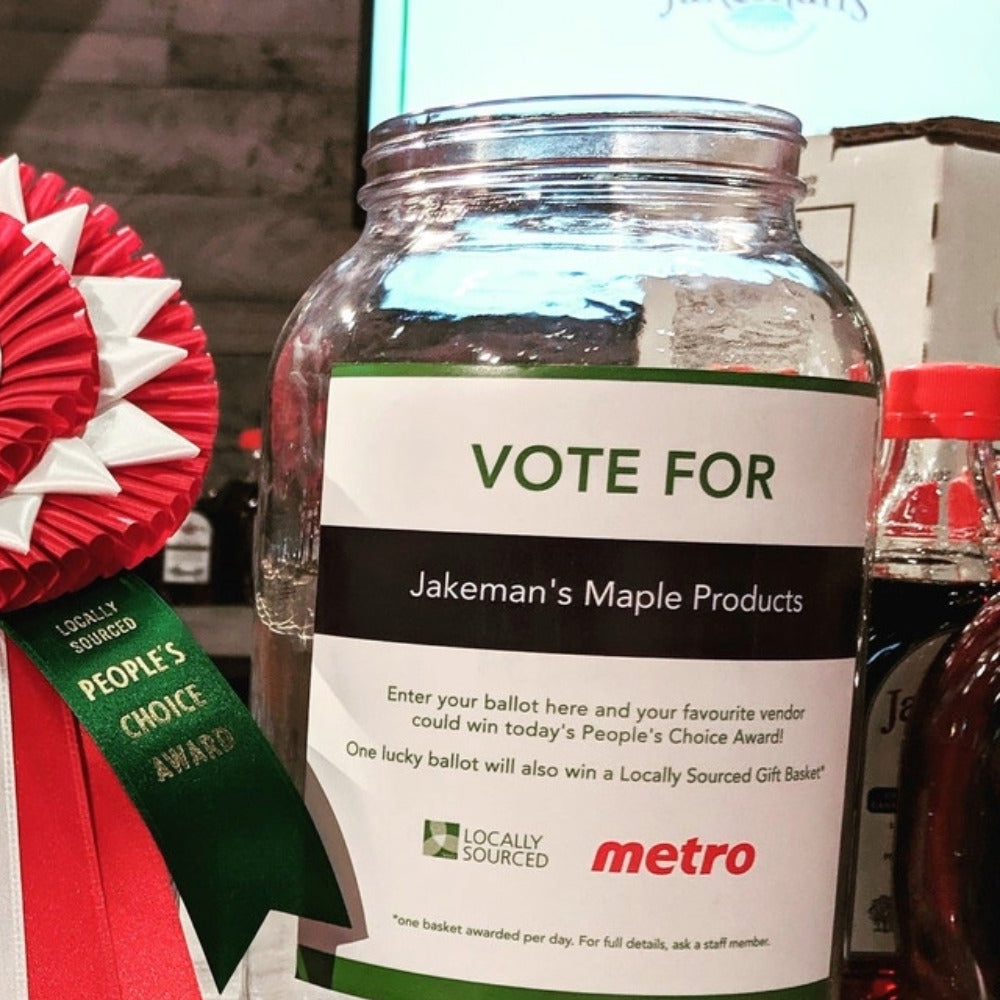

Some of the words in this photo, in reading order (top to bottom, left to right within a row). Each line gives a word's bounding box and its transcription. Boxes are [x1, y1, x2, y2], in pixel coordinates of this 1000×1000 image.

[471, 444, 641, 494] VOTE
[664, 451, 776, 500] FOR
[409, 571, 573, 607] Jakeman's
[584, 578, 682, 616] Maple
[692, 583, 804, 614] Products
[55, 600, 119, 637] LOCALLY
[69, 616, 138, 654] SOURCED
[77, 641, 187, 702] PEOPLE'S
[119, 682, 208, 740] CHOICE
[387, 686, 433, 704] Enter
[436, 694, 478, 710] your
[483, 694, 540, 713] ballot
[545, 698, 589, 716] here
[595, 703, 631, 718] and
[635, 705, 678, 721] your
[683, 703, 756, 721] favourite
[759, 705, 806, 721] vendor
[411, 713, 461, 731] could
[466, 718, 499, 734] win
[505, 721, 576, 743] today's
[581, 725, 663, 746] People's
[668, 728, 729, 745] Choice
[732, 729, 785, 745] Award!
[151, 726, 235, 783] AWARD
[346, 740, 378, 760] One
[381, 745, 424, 769] lucky
[427, 751, 480, 772] ballot
[484, 758, 516, 774] will
[521, 760, 559, 778] also
[564, 764, 597, 780] win
[603, 770, 614, 780] a
[619, 766, 682, 788] Locally
[686, 767, 752, 784] Sourced
[755, 767, 783, 783] Gift
[461, 847, 550, 869] SOURCED
[463, 828, 544, 850] LOCALLY
[590, 836, 757, 876] metro
[422, 919, 463, 935] basket
[465, 925, 520, 942] awarded
[522, 933, 546, 947] per
[548, 933, 575, 947] day.
[578, 935, 600, 948] For
[603, 936, 623, 949] full
[626, 936, 669, 951] details,
[671, 937, 691, 950] ask
[703, 936, 728, 950] staff
